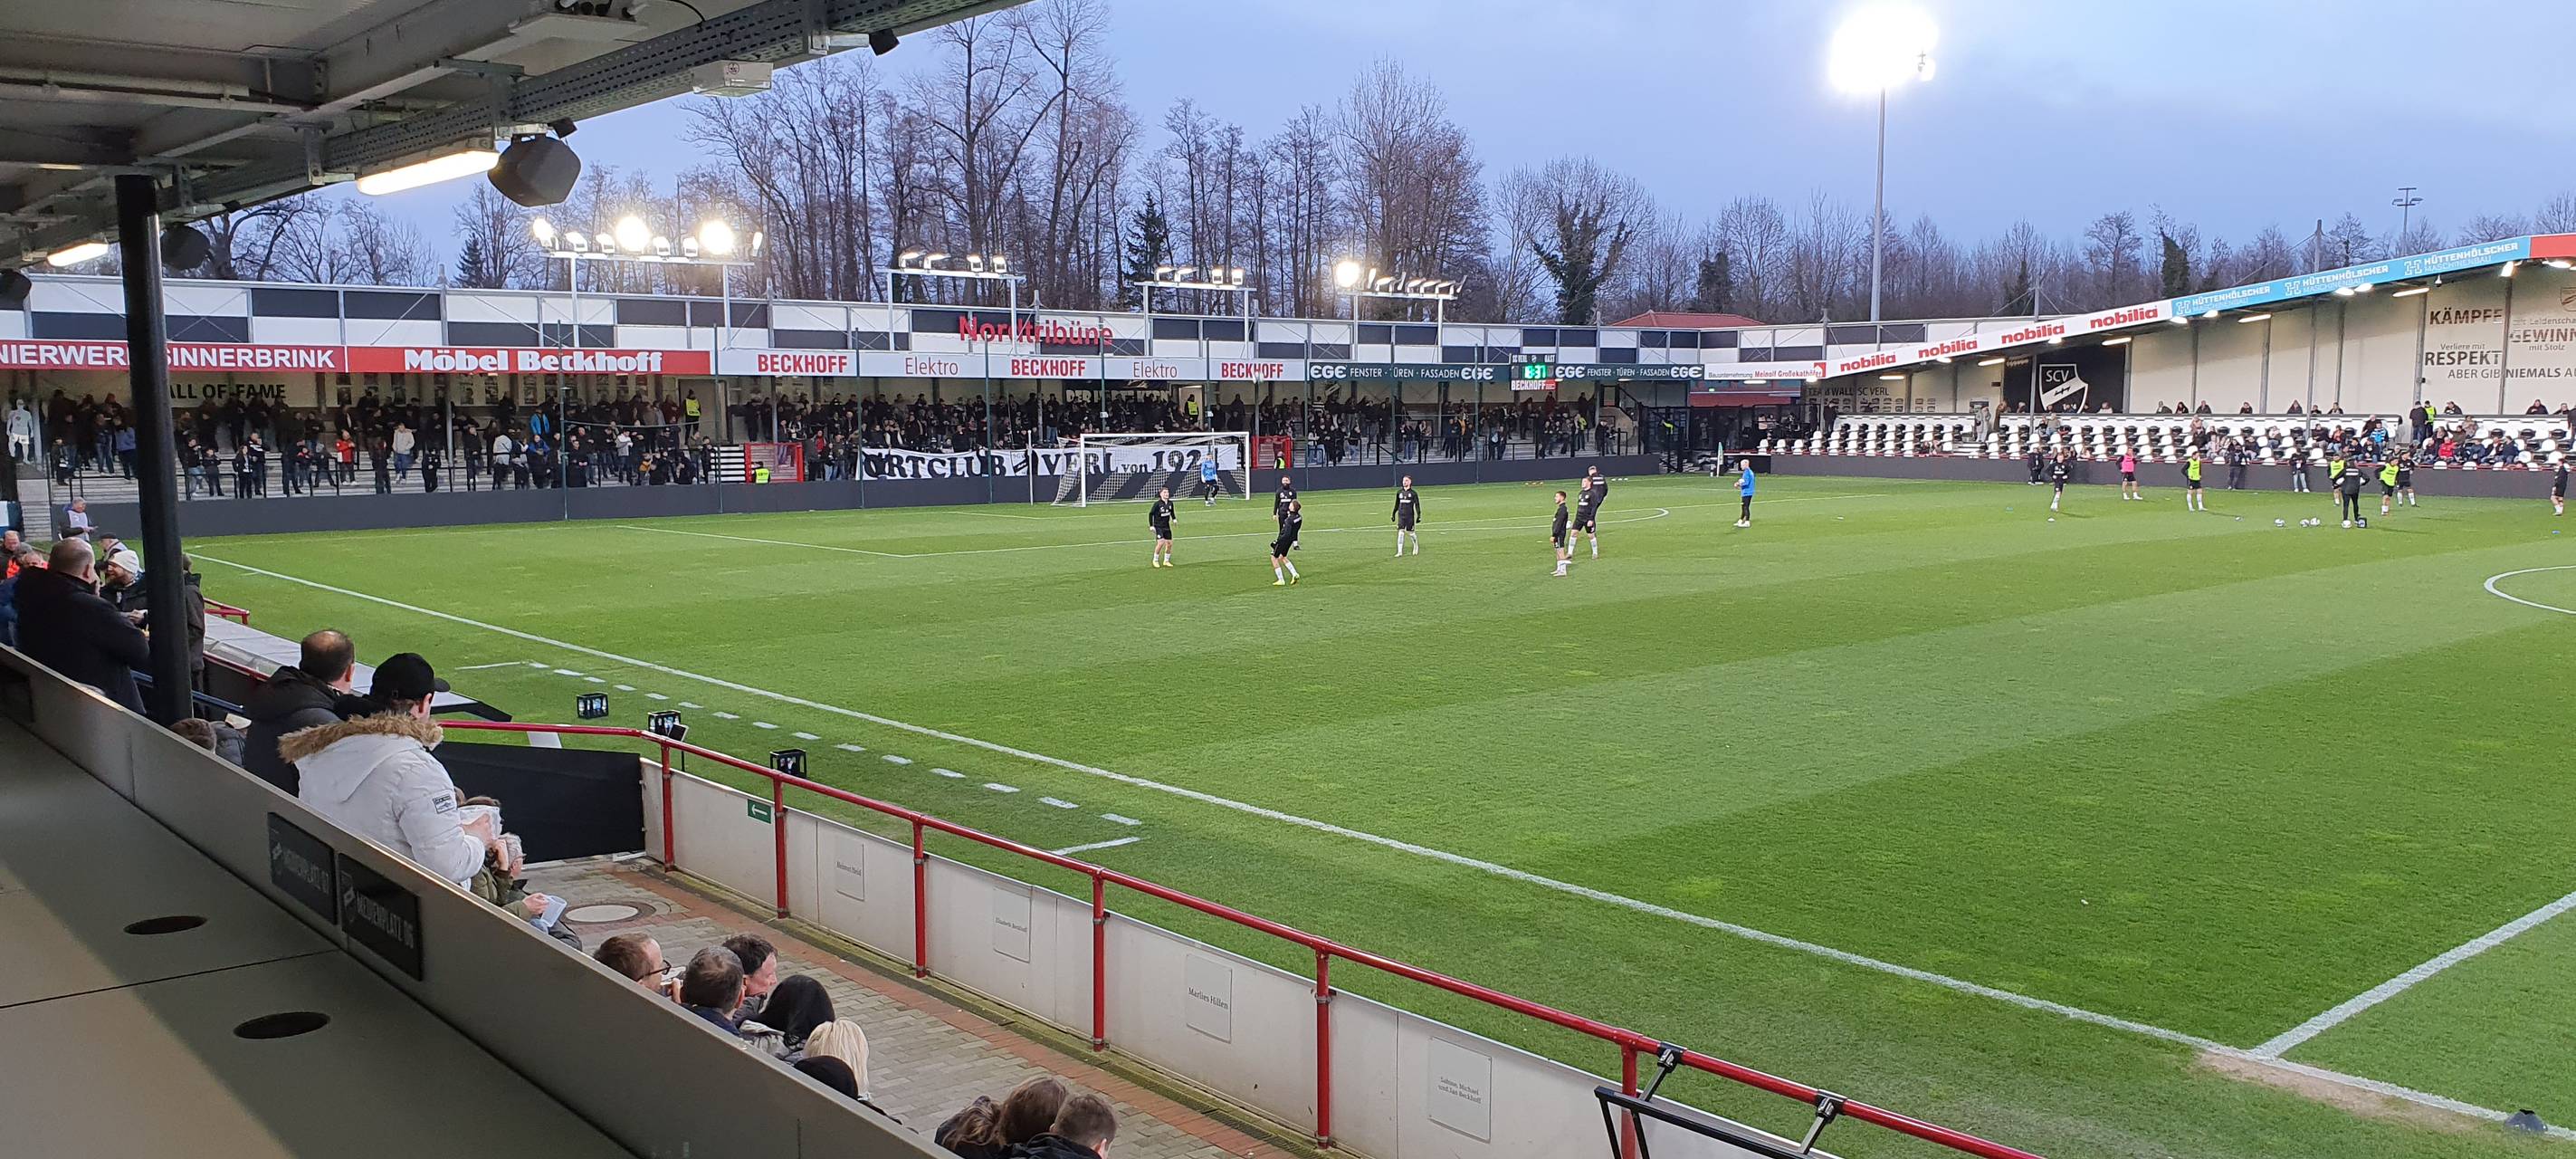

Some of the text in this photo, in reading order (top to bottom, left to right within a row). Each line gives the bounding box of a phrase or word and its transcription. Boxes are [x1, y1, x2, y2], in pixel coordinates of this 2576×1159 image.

[2424, 243, 2518, 265] HÜTTENHÖLSCHER
[2425, 255, 2492, 273] MASCHINENBAU
[2302, 264, 2390, 287] HÜTTENHÖLSCHER
[2192, 286, 2271, 306] HÜTTENHÖLSCHER
[2090, 308, 2159, 330] nobilia
[2429, 307, 2504, 325] KÄMPFE
[959, 316, 1114, 347] Nordtribüne
[2001, 323, 2065, 344] nobilia
[1918, 337, 1978, 359] nobilia
[2440, 342, 2485, 350] Verliere mit
[2544, 343, 2565, 351] Stolz
[0, 344, 129, 367] NIERWER
[404, 349, 663, 372] Möbel Beckhoff
[758, 354, 847, 373] BECKHOFF
[1840, 351, 1896, 372] nobilia
[2425, 350, 2503, 366] RESPEKT
[905, 357, 959, 376] Elektro
[1011, 359, 1086, 377] BECKHOFF
[1133, 361, 1178, 378] Elektro
[1222, 362, 1283, 378] BECKHOFF
[1310, 365, 1346, 379] EGE
[1350, 368, 1382, 378] FENSTER
[1389, 367, 1414, 378] ÜREN
[1420, 369, 1460, 378] FASSADEN
[1555, 366, 1585, 378] EGE
[1587, 369, 1611, 377] FENSTER
[1617, 367, 1635, 377] TÜREN
[1639, 369, 1670, 377] FASSADEN
[2046, 369, 2069, 382] SCV
[2447, 368, 2576, 379] ABER GIB NIEMALS A
[203, 384, 227, 399] OF
[235, 384, 286, 400] FAME
[1512, 379, 1546, 390] BECKHOFF
[1831, 387, 1854, 396] WALL
[1858, 387, 1868, 396] SC
[1870, 387, 1889, 396] VERL
[1041, 452, 1119, 476] VERL
[1121, 462, 1148, 474] von
[1152, 450, 1219, 473] 192
[1188, 987, 1209, 1002] Marlies
